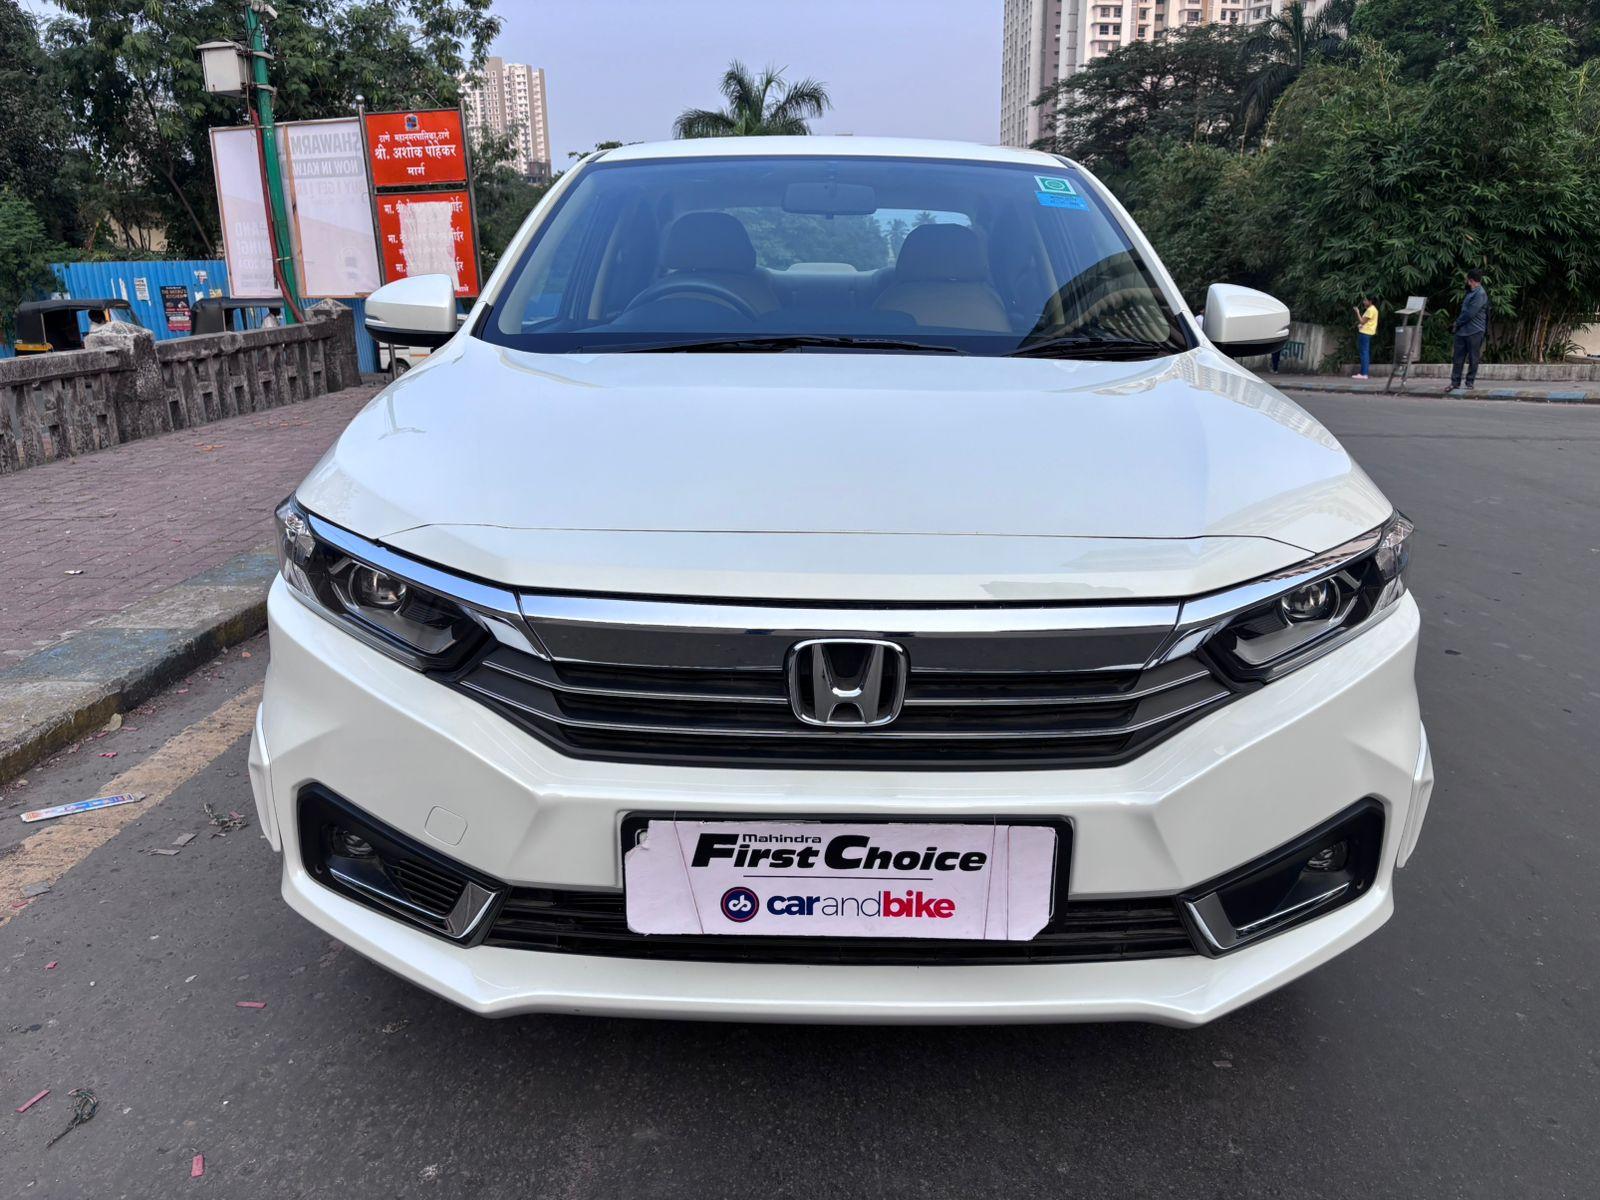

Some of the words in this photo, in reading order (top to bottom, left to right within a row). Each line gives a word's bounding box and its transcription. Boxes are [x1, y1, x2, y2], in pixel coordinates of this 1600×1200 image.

[393, 141, 423, 159] अशोक
[425, 140, 456, 159] पोहेकर
[407, 162, 425, 175] मार्ग
[742, 834, 822, 844] Mahindra
[691, 833, 820, 869] First
[824, 834, 987, 871] Choice
[766, 890, 956, 919] carandbike
